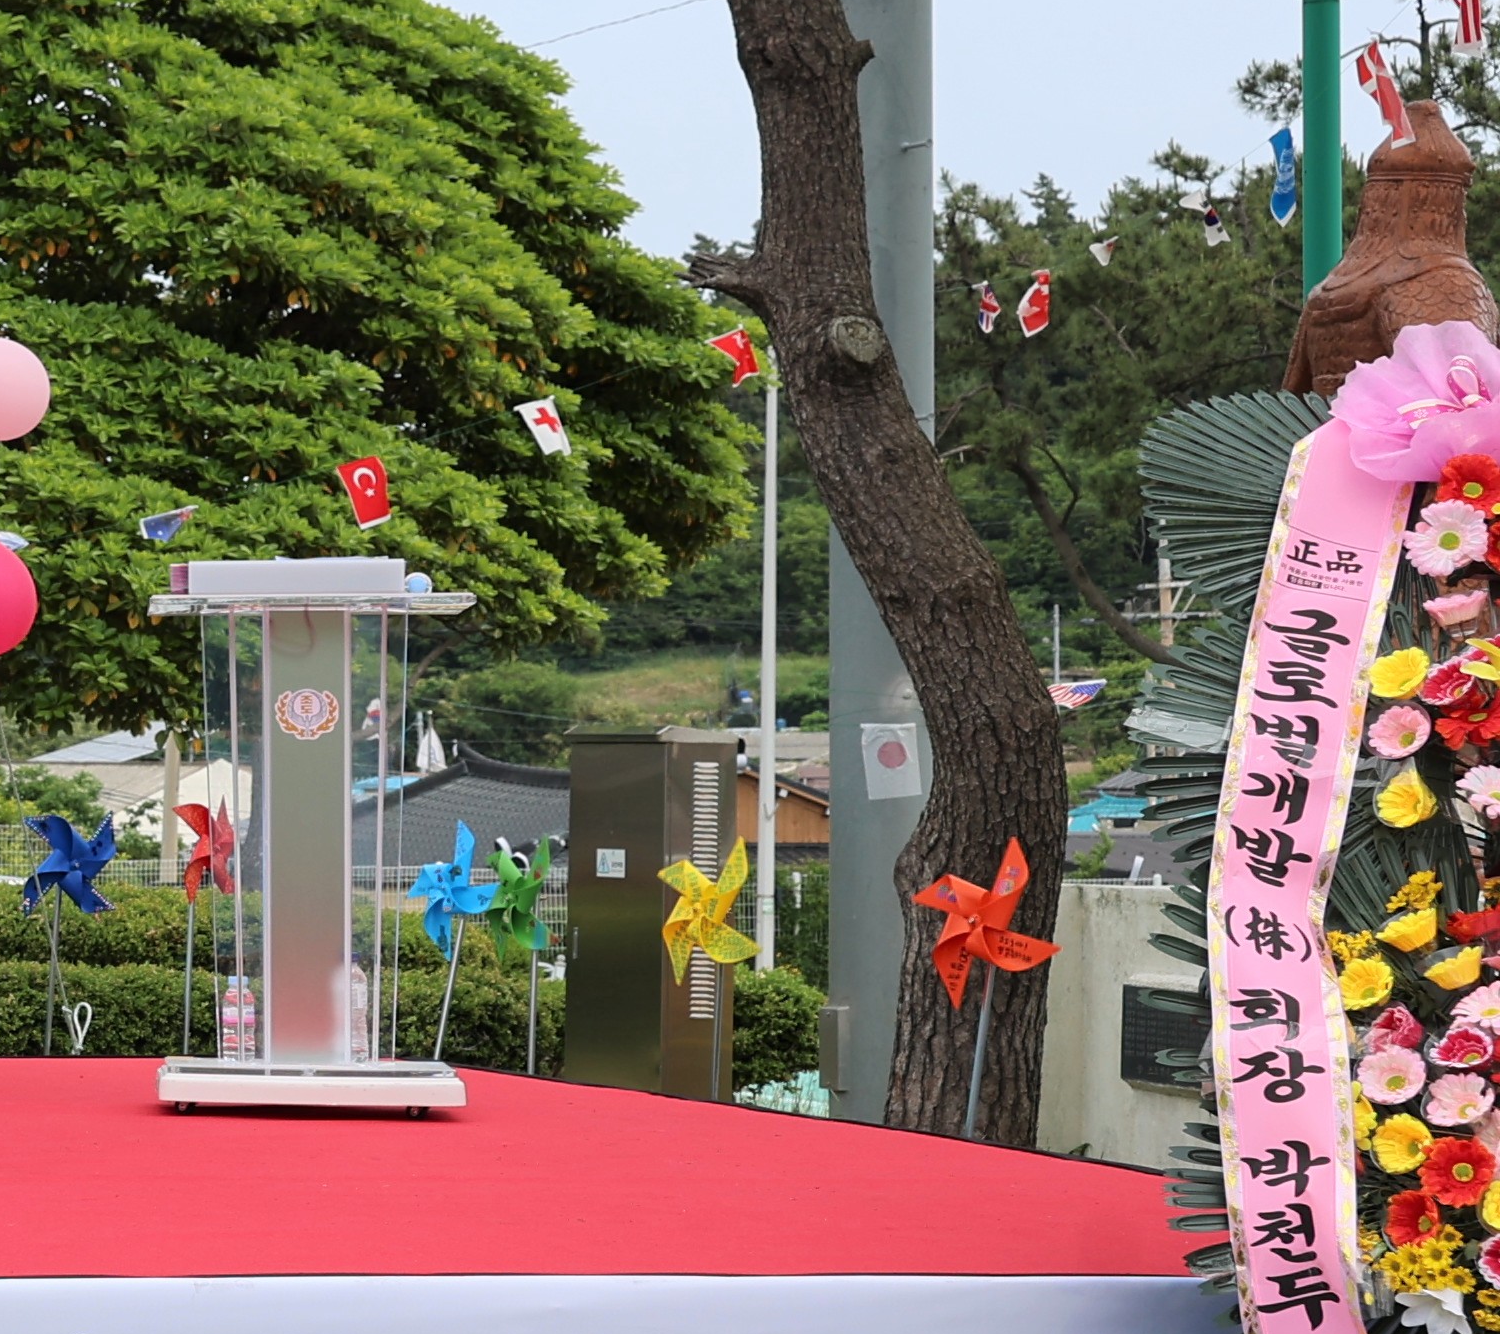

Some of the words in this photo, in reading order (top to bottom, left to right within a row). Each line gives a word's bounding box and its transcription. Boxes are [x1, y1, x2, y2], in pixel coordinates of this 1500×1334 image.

[1286, 539, 1364, 574] 正品
[1231, 609, 1351, 888] 글로벌개발
[1229, 988, 1326, 1103] 회장
[1240, 1140, 1341, 1331] 박천두
